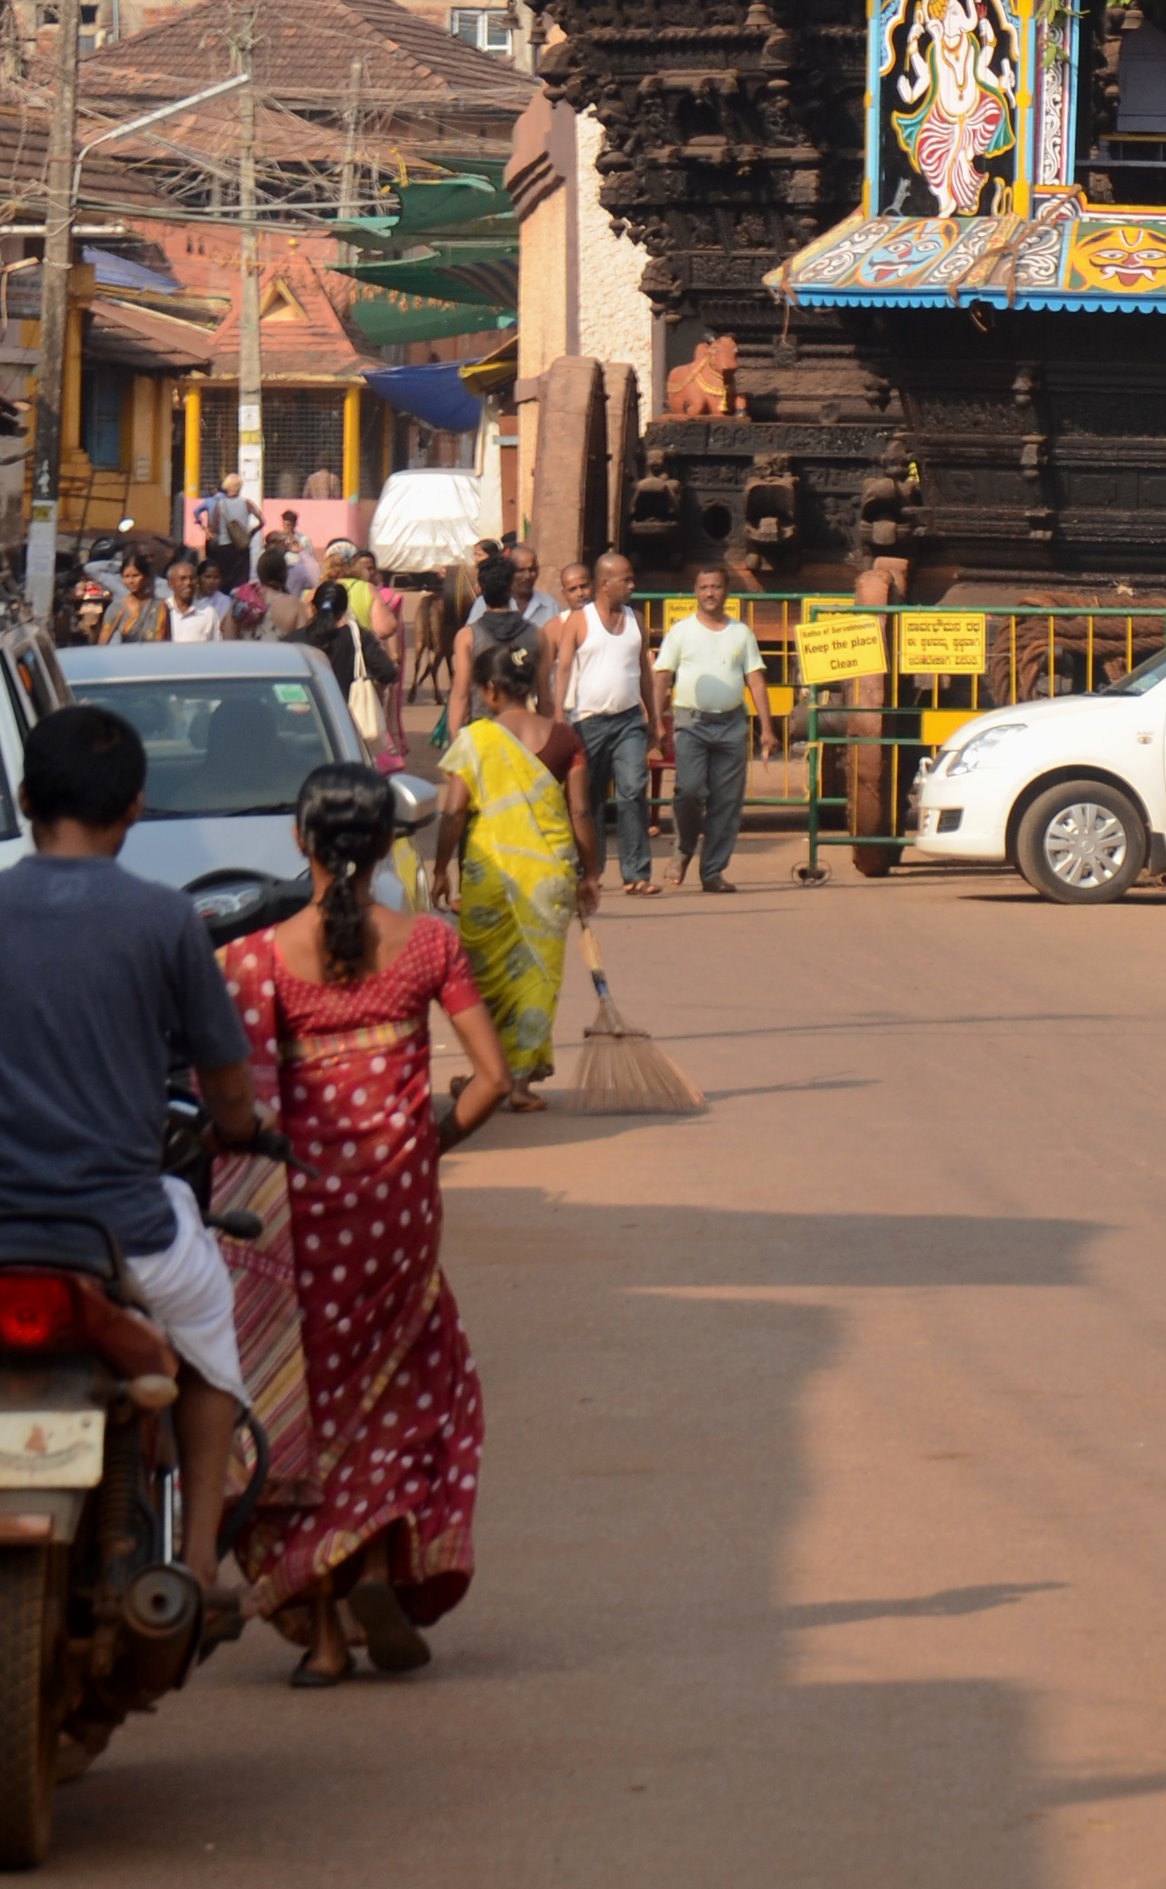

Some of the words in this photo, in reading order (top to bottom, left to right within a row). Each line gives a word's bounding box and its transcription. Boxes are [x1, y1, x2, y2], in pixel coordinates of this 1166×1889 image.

[804, 643, 829, 654] Keep
[832, 639, 848, 650] the
[851, 636, 878, 649] place
[830, 658, 858, 670] Clean
